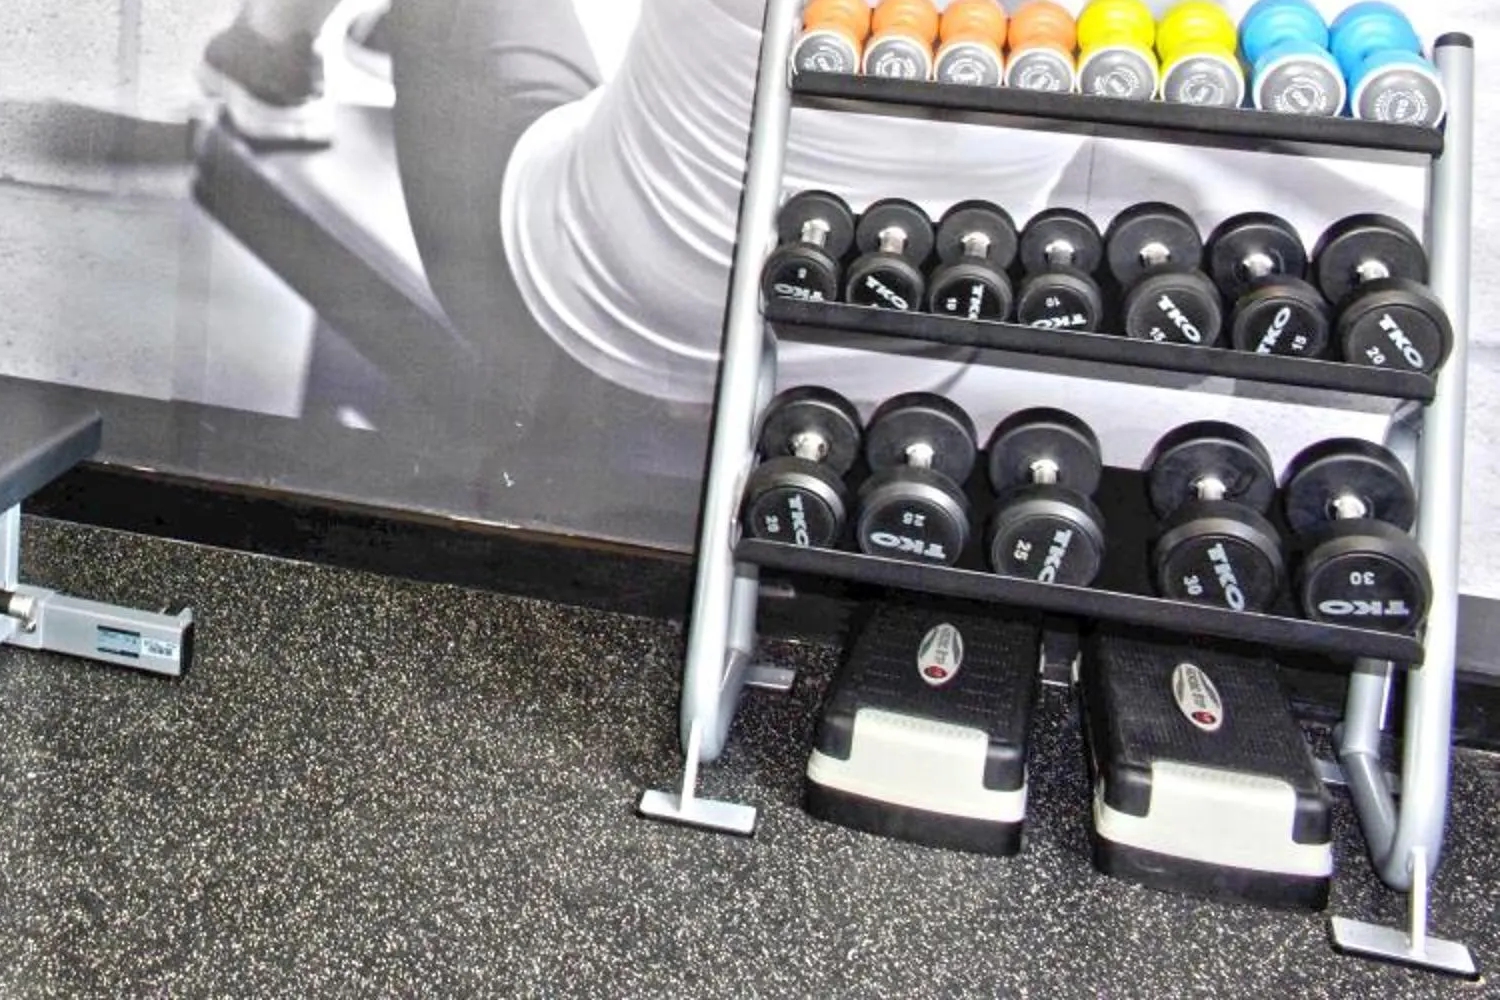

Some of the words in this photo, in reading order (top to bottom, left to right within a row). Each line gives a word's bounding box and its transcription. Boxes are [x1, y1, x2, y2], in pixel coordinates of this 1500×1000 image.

[774, 282, 825, 302] TKO
[865, 275, 909, 311] TKO
[1030, 313, 1088, 330] TKO
[1156, 295, 1202, 344] TKO
[1255, 307, 1292, 354] TKO
[1364, 346, 1386, 366] 20
[1378, 314, 1424, 369] TKO
[788, 494, 811, 549] TKO
[869, 531, 948, 560] TKO
[1012, 539, 1033, 562] 25
[1036, 527, 1074, 584] TKO
[1182, 574, 1204, 597] 30
[1206, 543, 1246, 612] TKO
[1350, 571, 1376, 586] 30
[1318, 599, 1411, 617] TKO
